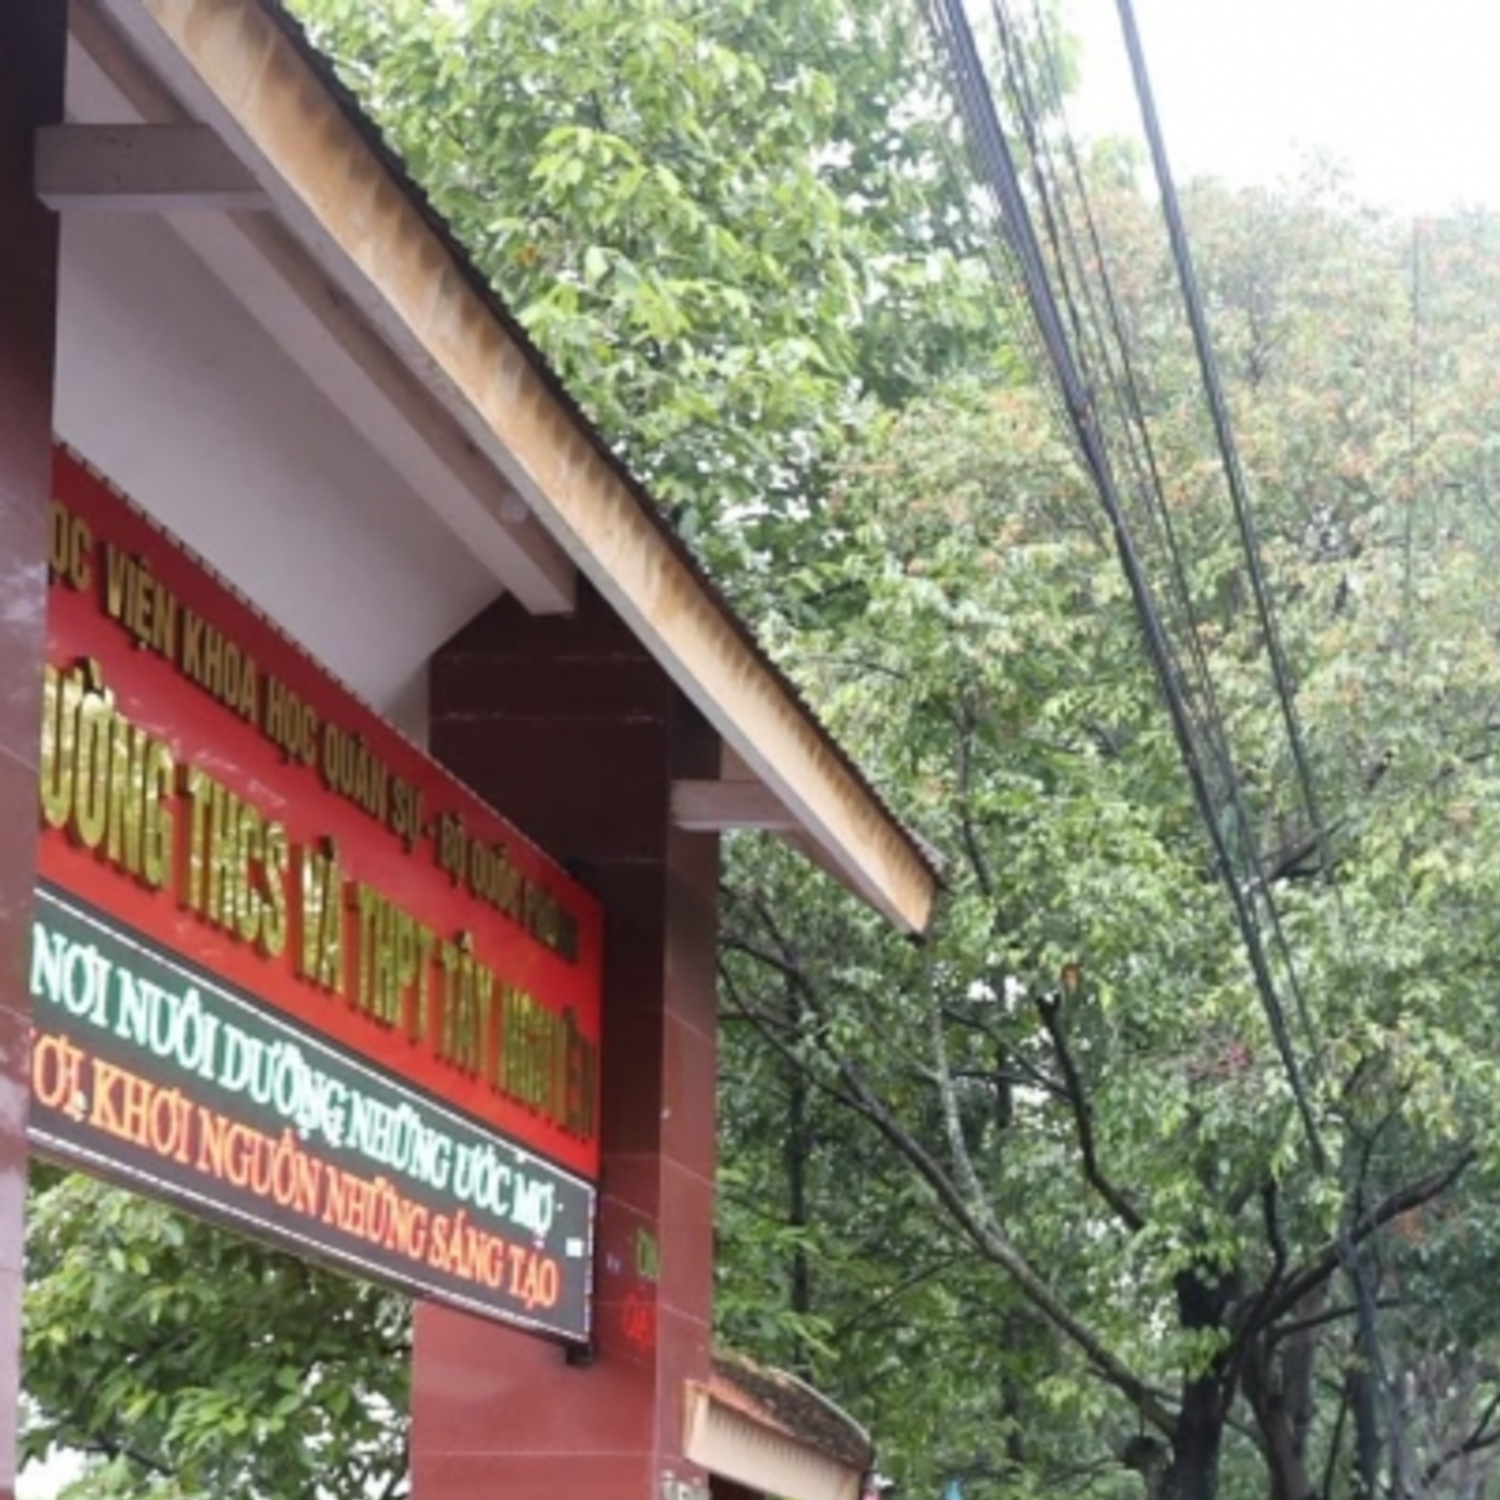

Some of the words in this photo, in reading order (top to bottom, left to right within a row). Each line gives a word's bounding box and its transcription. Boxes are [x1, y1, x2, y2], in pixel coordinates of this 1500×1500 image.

[106, 541, 177, 661] VIỆN
[182, 606, 258, 727] KHOA
[266, 671, 318, 769] HỌC
[30, 921, 113, 1029] NƠI
[114, 966, 221, 1081] NUÔI
[187, 762, 287, 957] THCS
[302, 835, 345, 996] VÀ
[357, 880, 436, 1042] THPT
[30, 1032, 84, 1121] ƠI
[91, 1056, 193, 1164] KHƠI
[428, 1208, 504, 1288] SÁNG
[508, 1244, 560, 1310] TẠO
